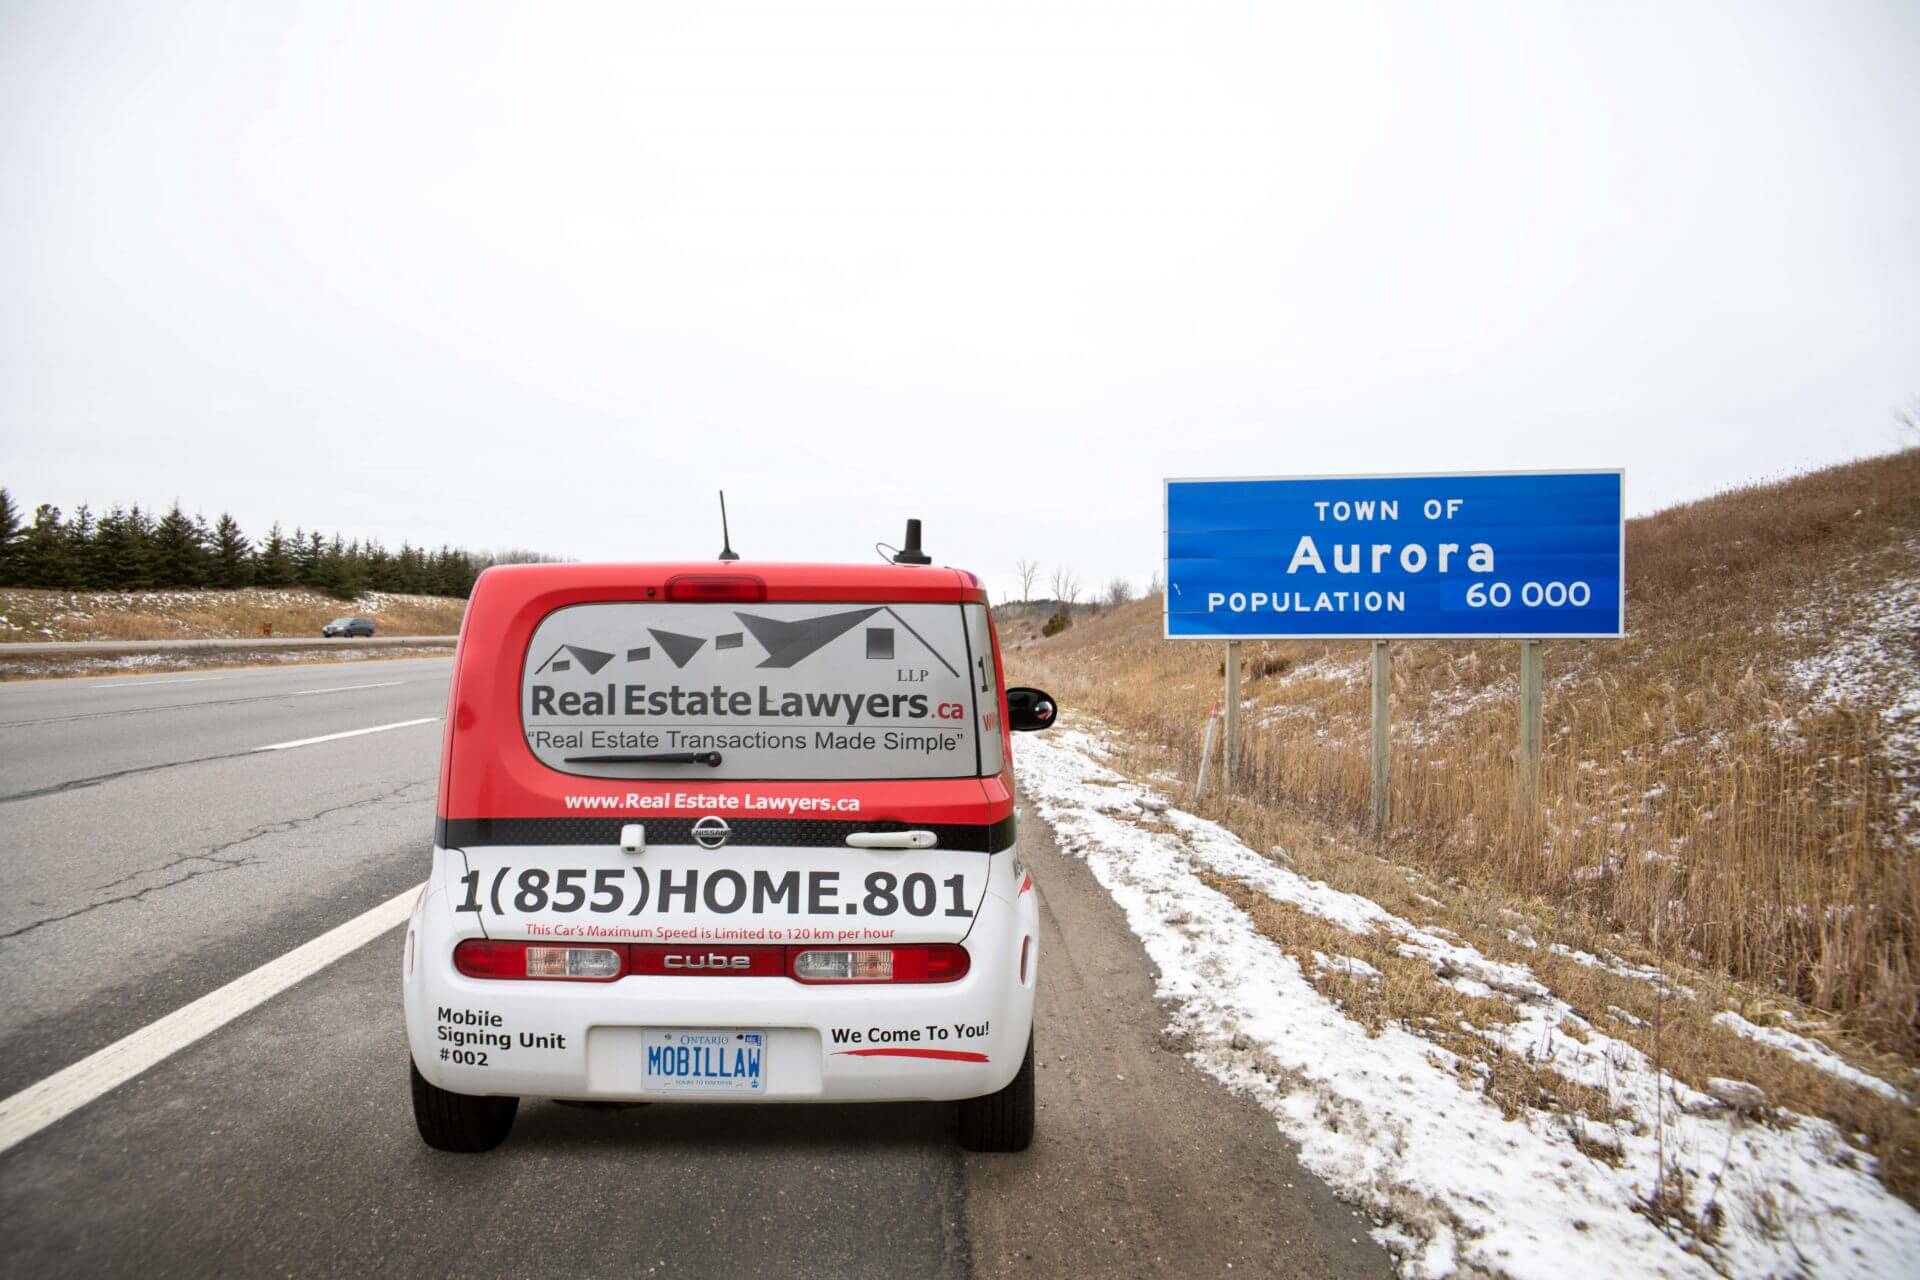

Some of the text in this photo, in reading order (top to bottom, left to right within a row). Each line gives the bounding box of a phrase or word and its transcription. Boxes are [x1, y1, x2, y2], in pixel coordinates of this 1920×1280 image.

[1314, 499, 1463, 521] TOWN OF
[1287, 536, 1494, 574] Aurora
[1208, 581, 1591, 613] POPULATION 60 000
[897, 669, 929, 682] LLP
[592, 731, 659, 749] Estate
[666, 731, 807, 750] Transactions
[815, 732, 876, 750] Made
[455, 866, 975, 918] 1(855)HOME.801
[526, 923, 895, 941] This Car's Maximum Speed is Limited to 120 km per hour
[664, 953, 751, 969] cube
[438, 1025, 566, 1050] Signing Unit
[680, 1034, 729, 1045] ONTARIO
[832, 1021, 989, 1043] We Come To You!
[440, 1047, 489, 1067] #002
[648, 1046, 760, 1077] MOBILLAW
